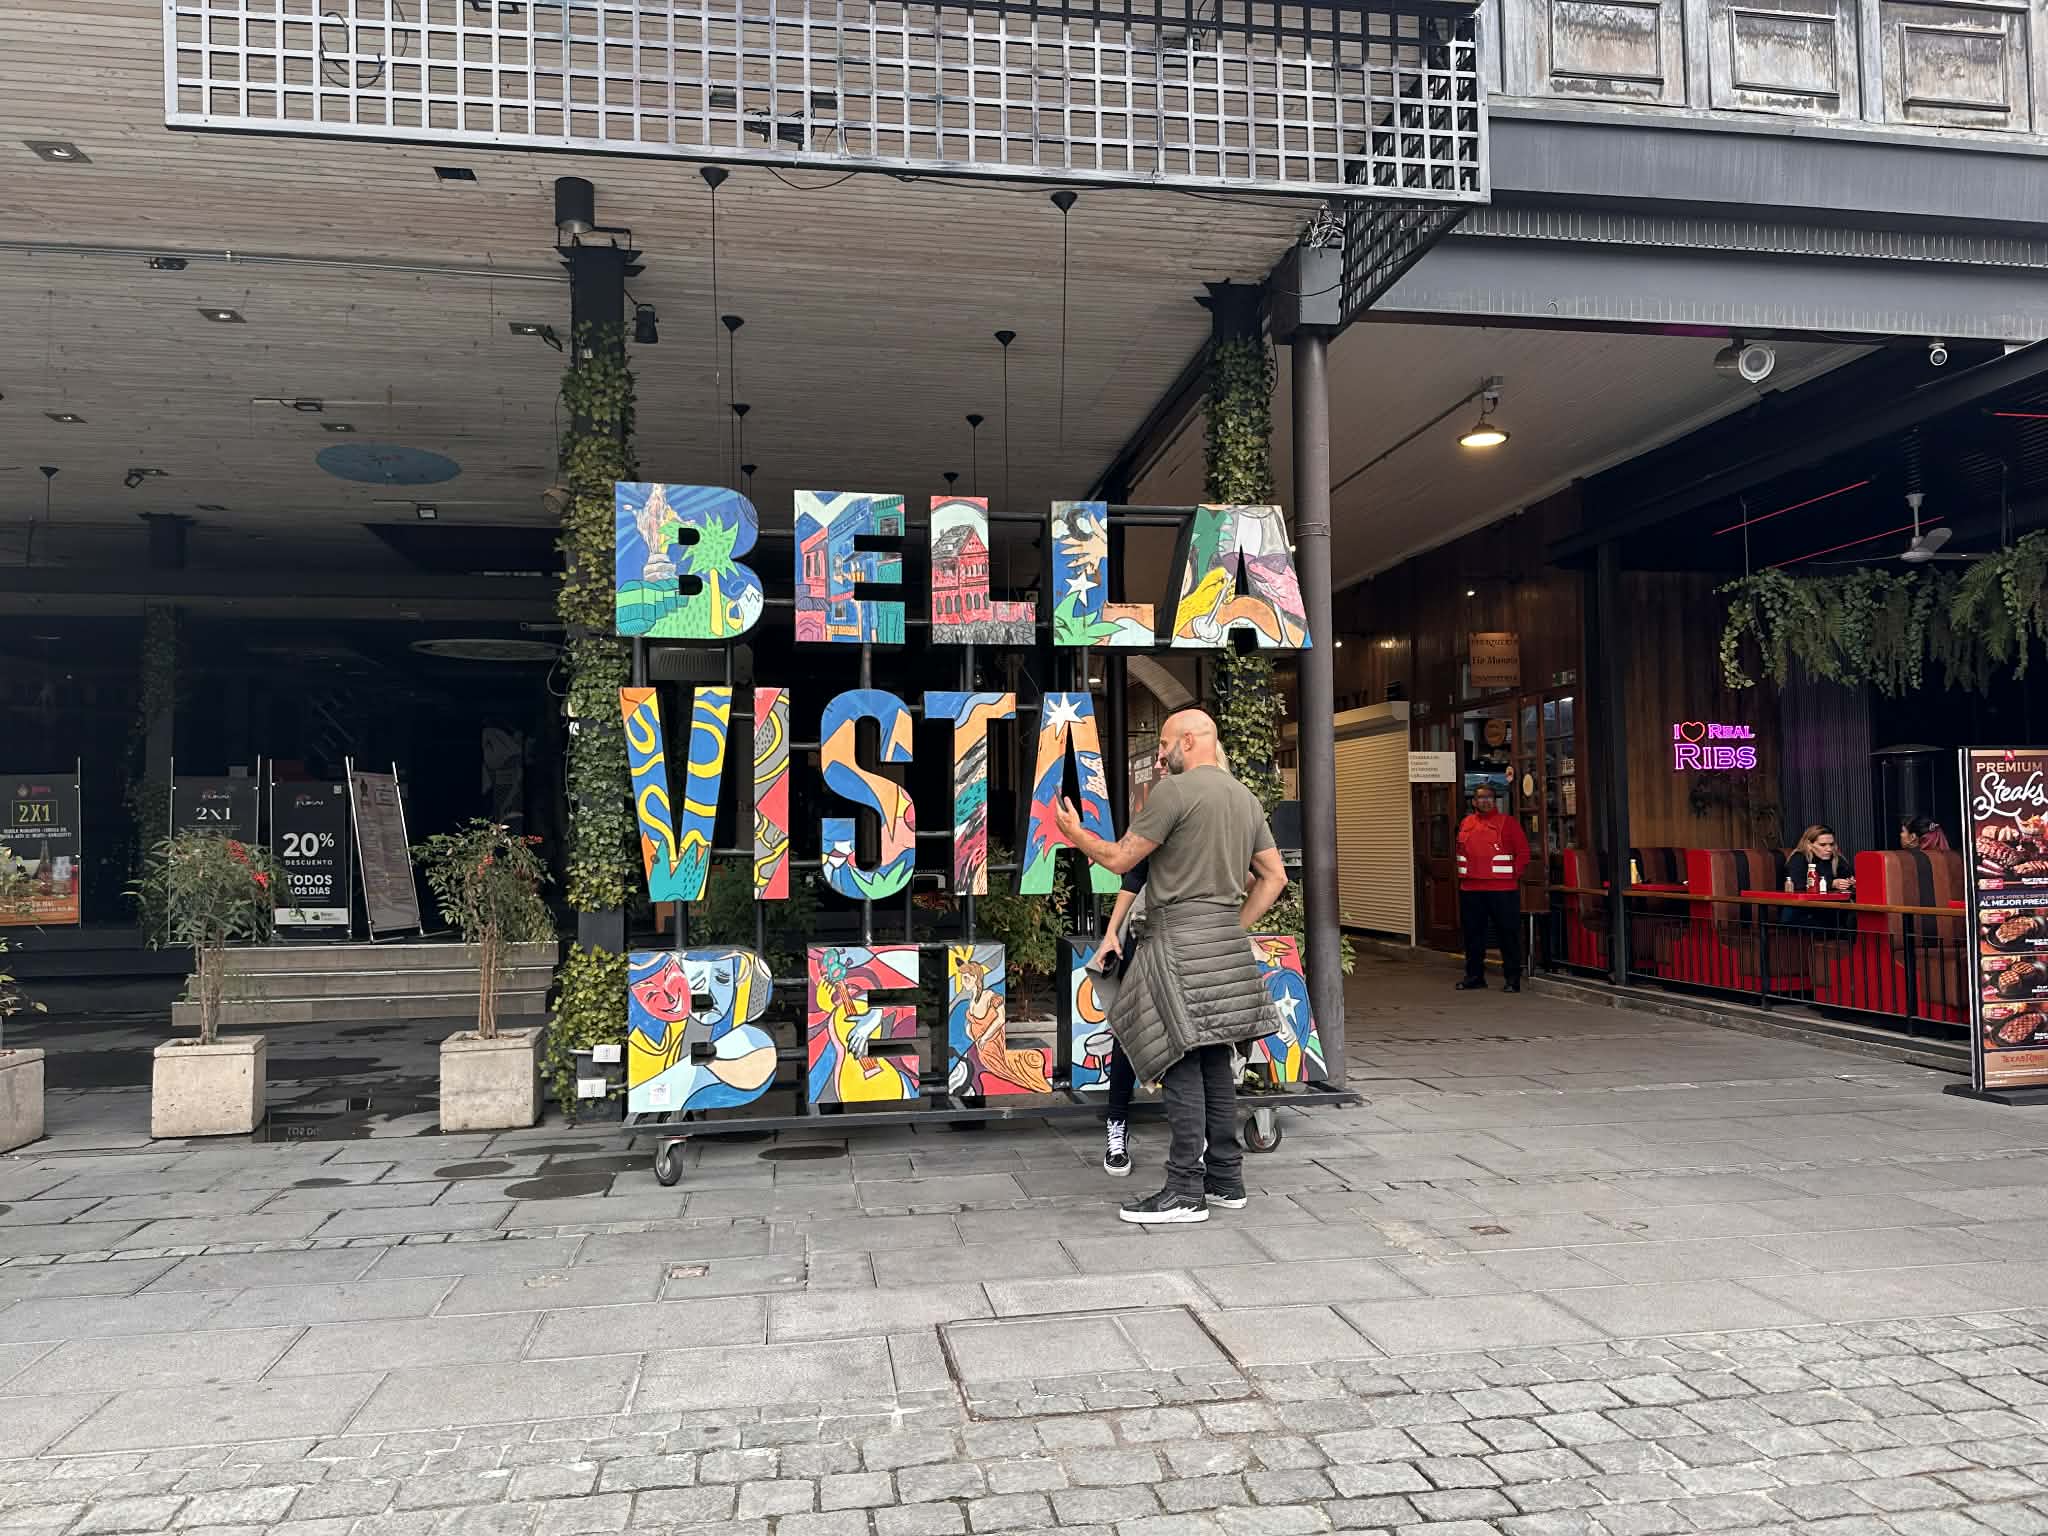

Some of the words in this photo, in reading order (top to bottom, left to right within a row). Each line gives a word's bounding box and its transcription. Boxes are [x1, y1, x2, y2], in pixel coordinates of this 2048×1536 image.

[615, 482, 1313, 649] BELLA
[1673, 723, 1681, 739] I
[1707, 723, 1756, 739] REAL
[1674, 743, 1757, 770] RIBS
[1976, 760, 2043, 773] PREMIUM
[618, 687, 1121, 902] VISTA
[1973, 770, 2048, 820] Steaks
[19, 804, 50, 822] 2X1
[282, 832, 335, 857] 20%
[287, 874, 333, 886] TODOS
[1991, 899, 2022, 907] MEJOR
